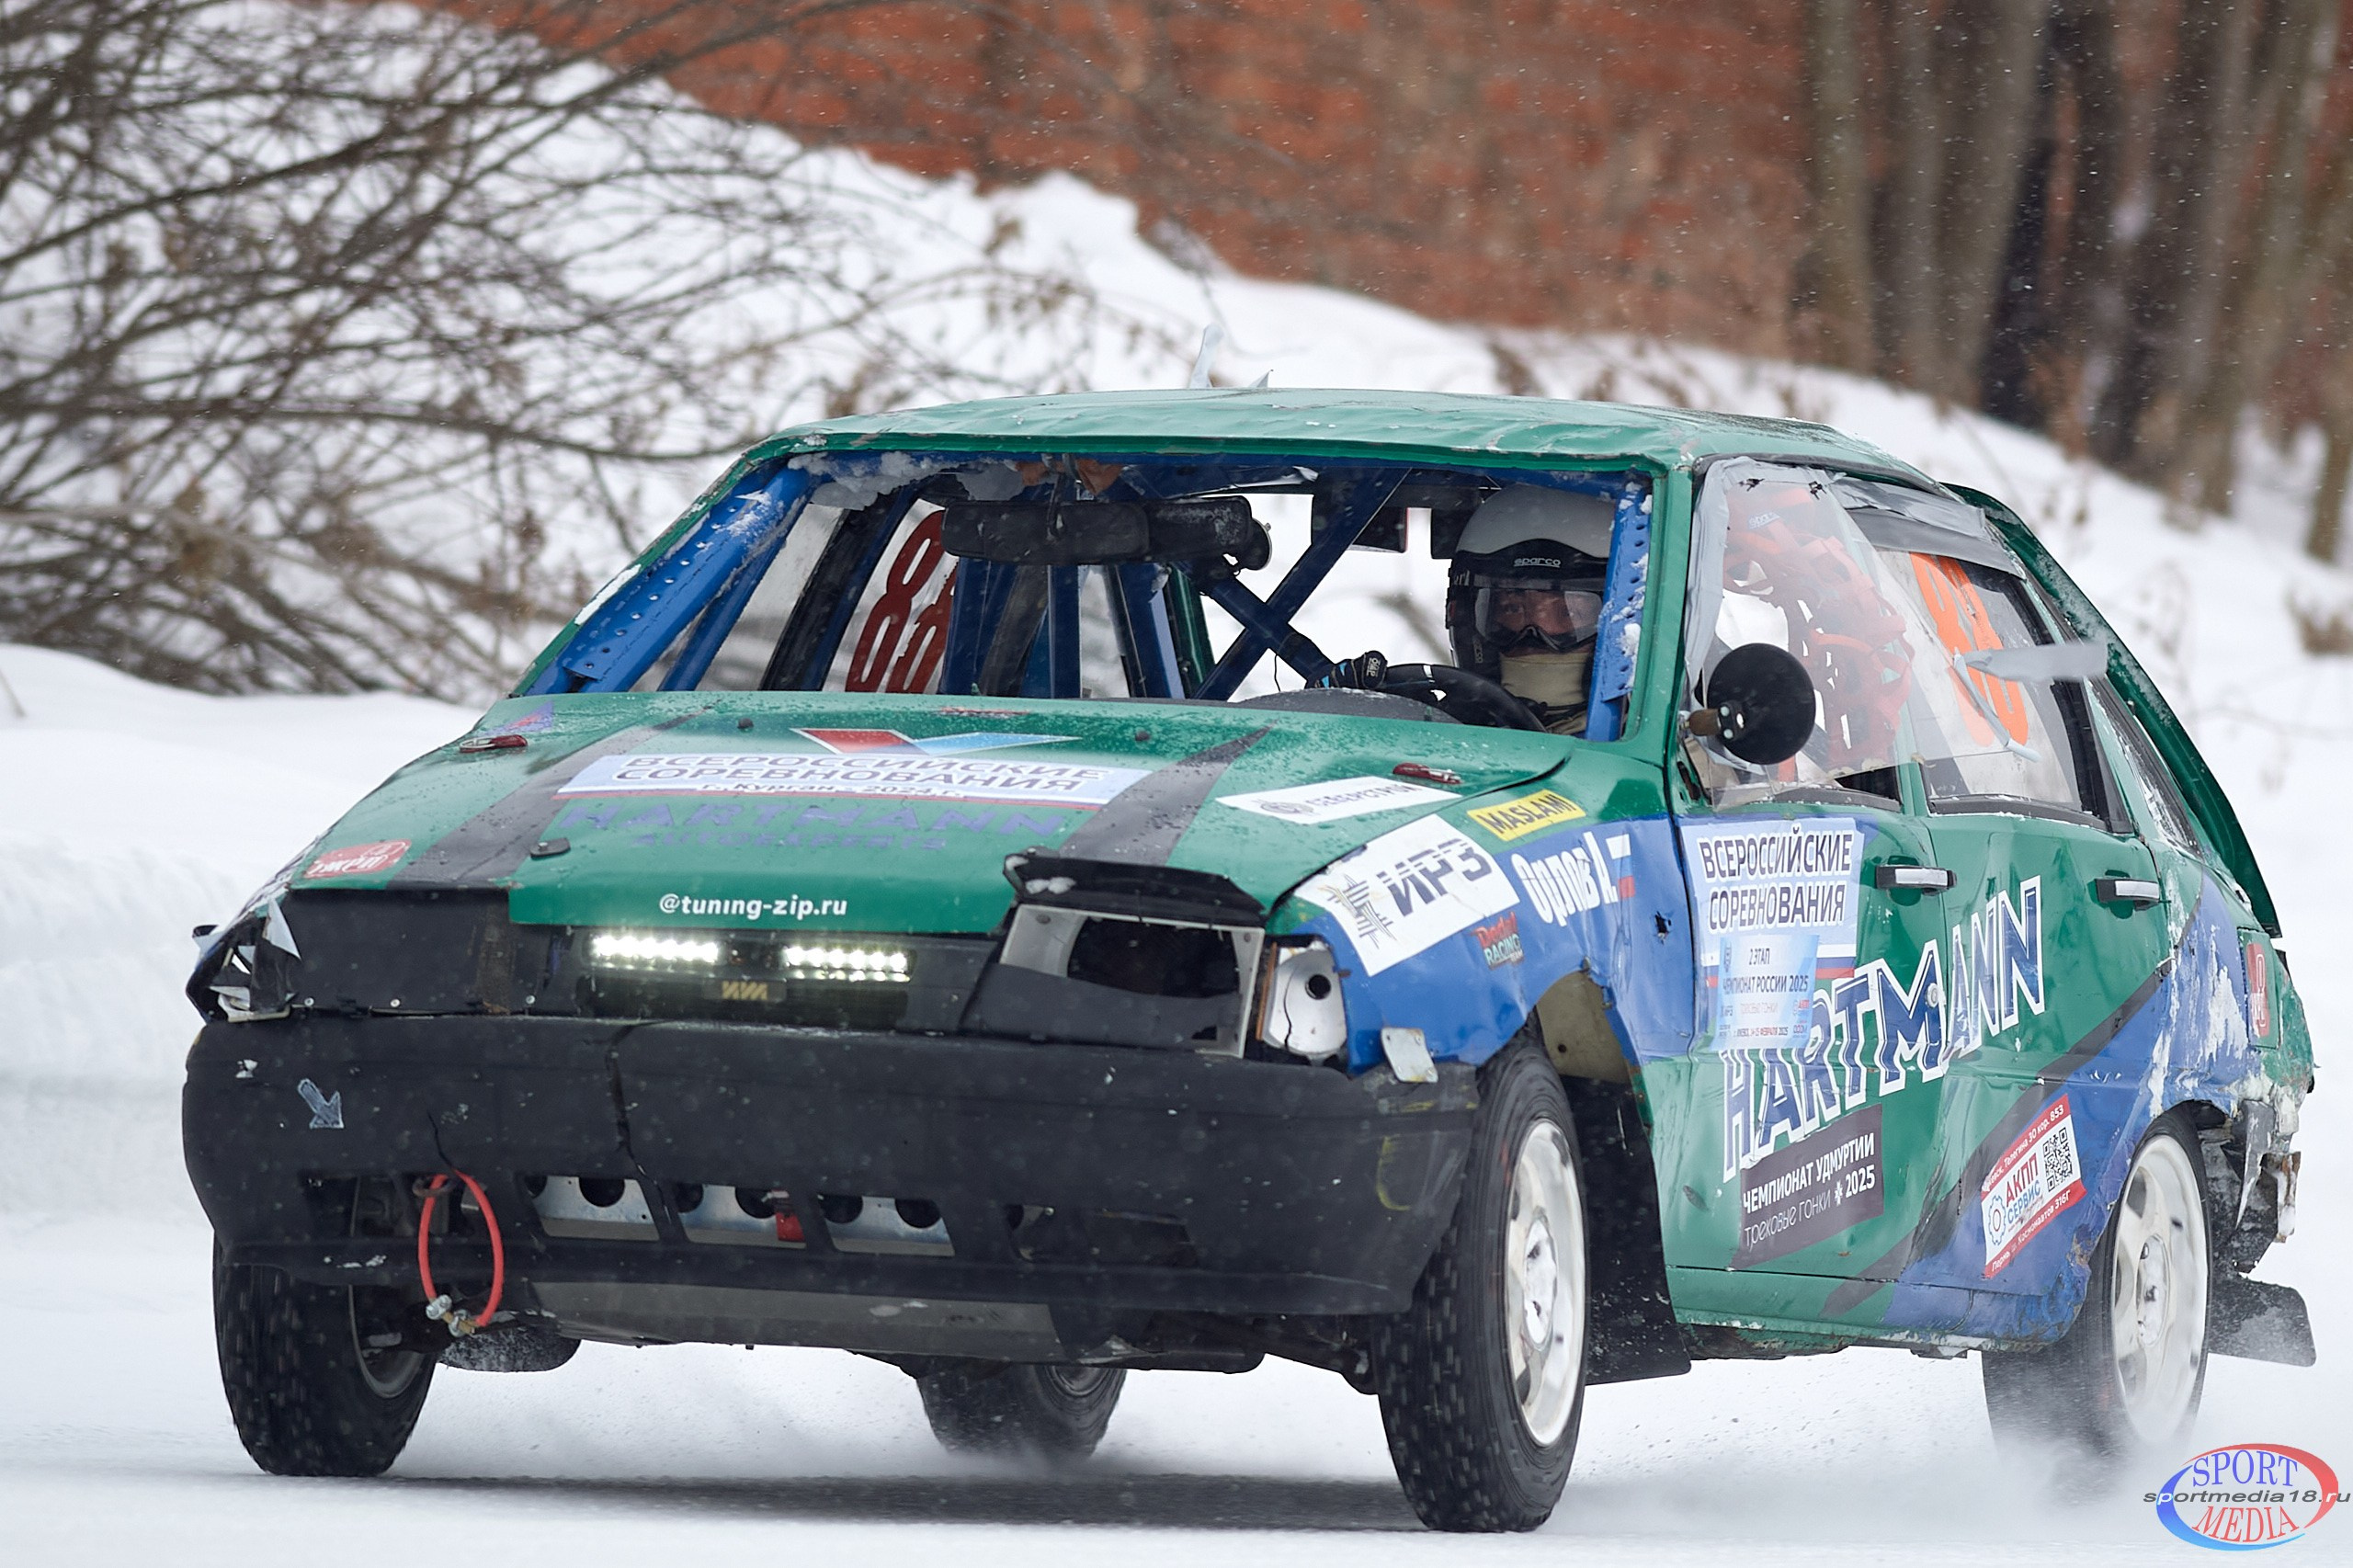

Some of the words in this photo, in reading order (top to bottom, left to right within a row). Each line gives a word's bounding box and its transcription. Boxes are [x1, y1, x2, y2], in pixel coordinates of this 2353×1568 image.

[1514, 556, 1562, 567] sparco
[615, 767, 1083, 790] СОРЕВНОВАНИЯ
[626, 754, 1109, 779] ВСЕРОССИЙСКИЕ
[735, 782, 835, 792] Курган
[558, 803, 1066, 836] HARTMANN
[1698, 824, 1854, 881] ВСЕРОССИЙСКИЕ
[1376, 837, 1493, 917] ИРЗ
[1510, 846, 1601, 927] Орлов
[658, 892, 848, 920] @tuning-zip.ru
[1709, 882, 1847, 930] СОРЕВНОВАНИЯ
[1483, 933, 1522, 967] RACING
[1722, 976, 1756, 994] ЧЕМПИОНАТ
[1756, 975, 1787, 993] РОССИИ
[1789, 974, 1809, 992] 2025
[1721, 875, 2046, 1183] HARTMANN
[2029, 1128, 2037, 1142] 30
[2050, 1104, 2064, 1121] 853
[1743, 1162, 1814, 1214] ЧЕМПИОНАТ
[1815, 1132, 1875, 1184] УДМУРТИИ
[1845, 1164, 1876, 1199] 2025
[2006, 1153, 2039, 1209] АКПП
[2007, 1181, 2041, 1224] СЕРВИС
